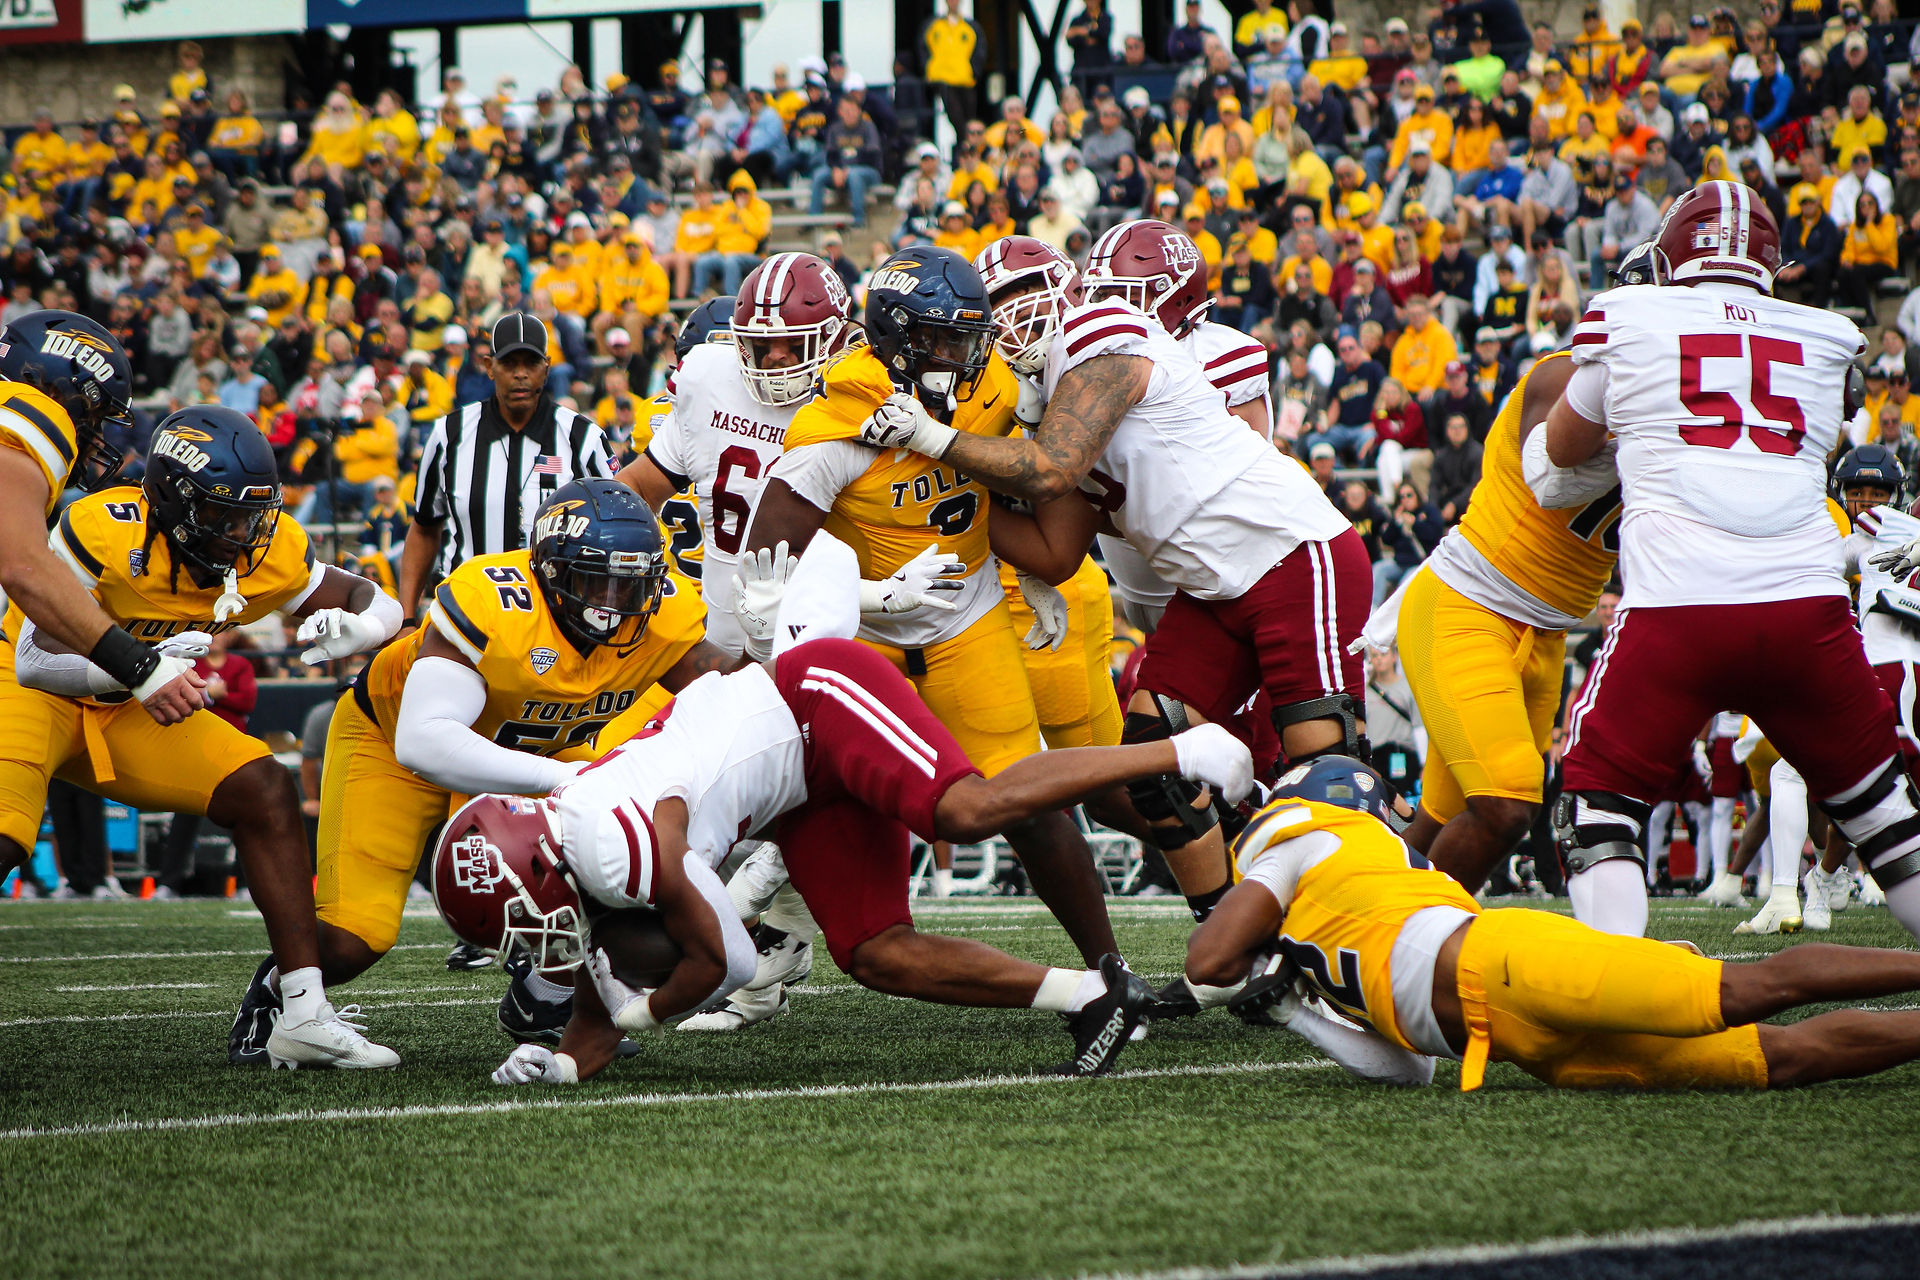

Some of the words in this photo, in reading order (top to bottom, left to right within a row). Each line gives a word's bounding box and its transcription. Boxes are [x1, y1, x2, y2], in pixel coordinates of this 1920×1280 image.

[868, 270, 920, 296] TOLEDO
[41, 331, 115, 382] TOLEDO
[1678, 333, 1807, 457] 55
[153, 431, 211, 473] TOLEDO
[104, 502, 143, 524] 5
[712, 444, 781, 556] 6
[535, 514, 590, 545] TOLEDO
[483, 566, 534, 613] 52
[531, 655, 556, 665] MAC
[520, 689, 637, 722] TOLEDO
[466, 835, 495, 894] MASS
[1076, 1006, 1125, 1074] DIZERO
